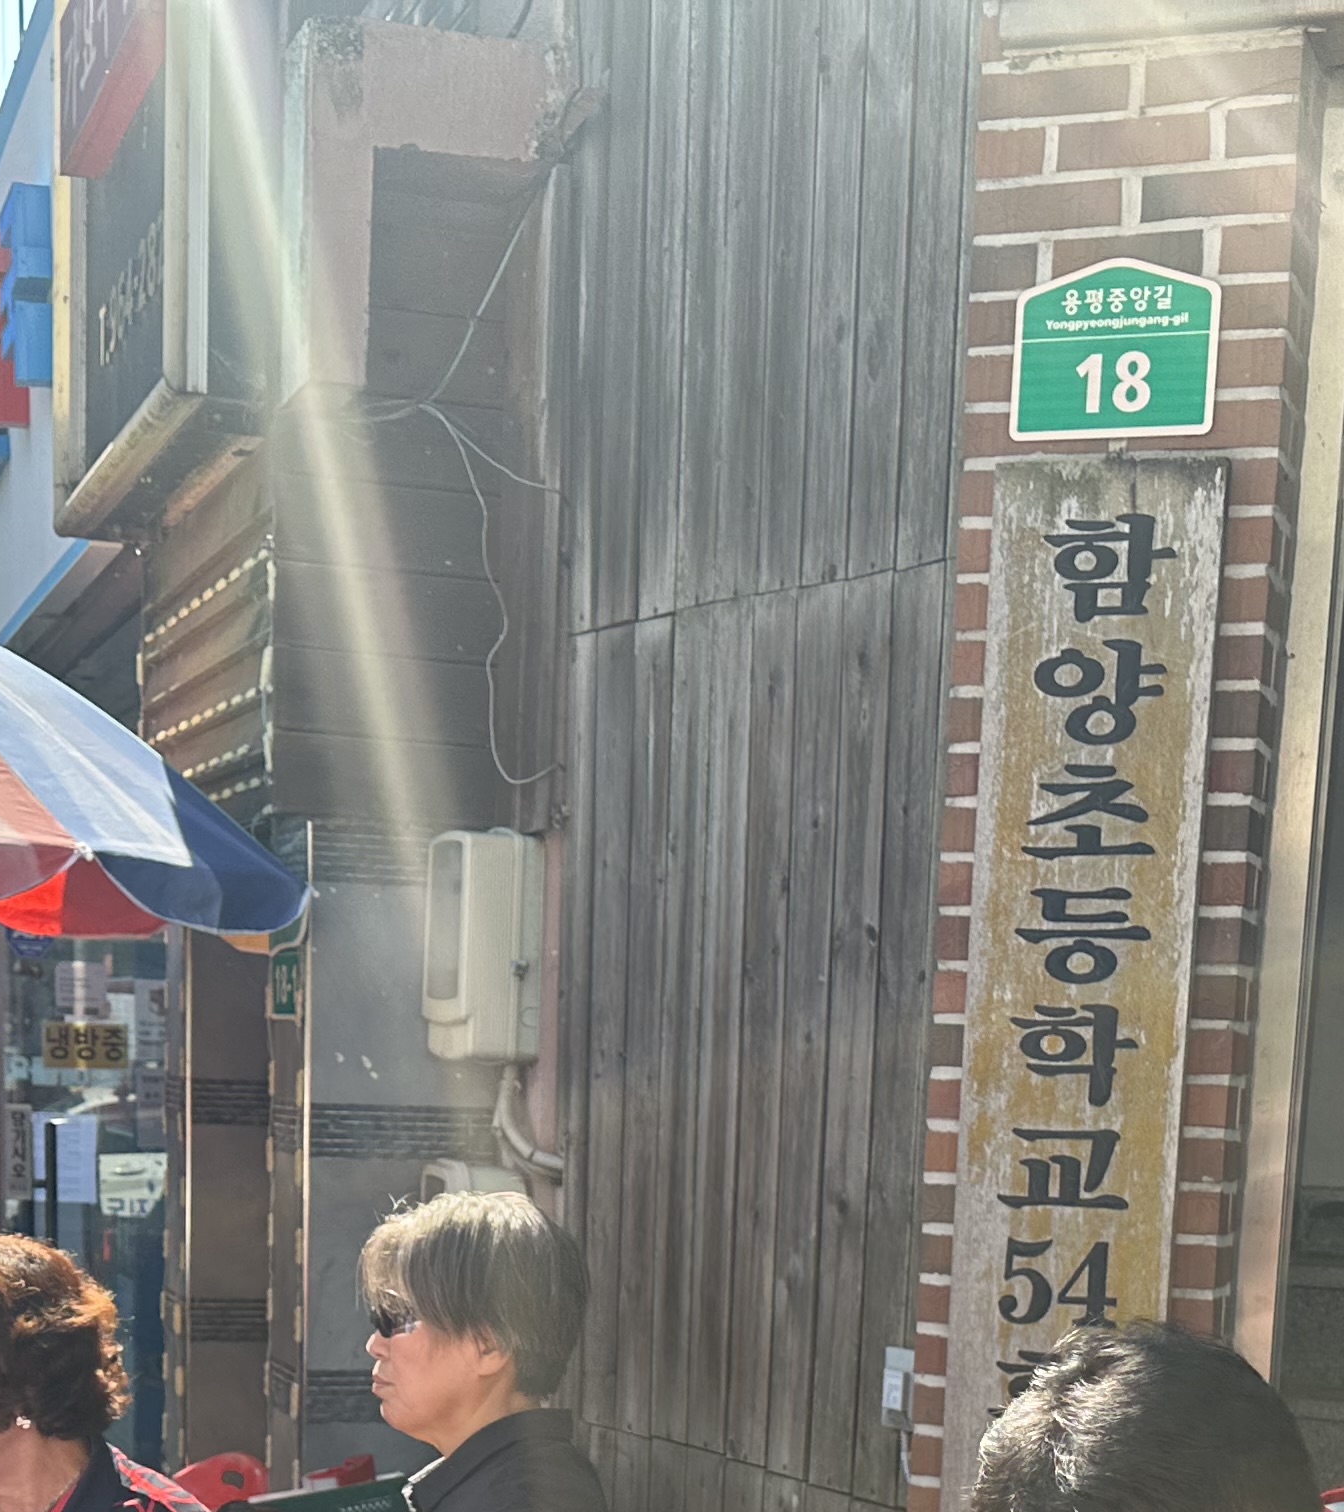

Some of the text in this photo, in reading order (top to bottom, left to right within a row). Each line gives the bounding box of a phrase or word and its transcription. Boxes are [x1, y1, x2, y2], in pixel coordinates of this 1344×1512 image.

[1060, 284, 1173, 316] 용평중앙길
[1045, 312, 1189, 332] Yongpyeongjungang-gil
[1075, 350, 1152, 414] 18
[995, 511, 1177, 1212] 함양초등학교
[45, 1026, 125, 1062] 냉방중
